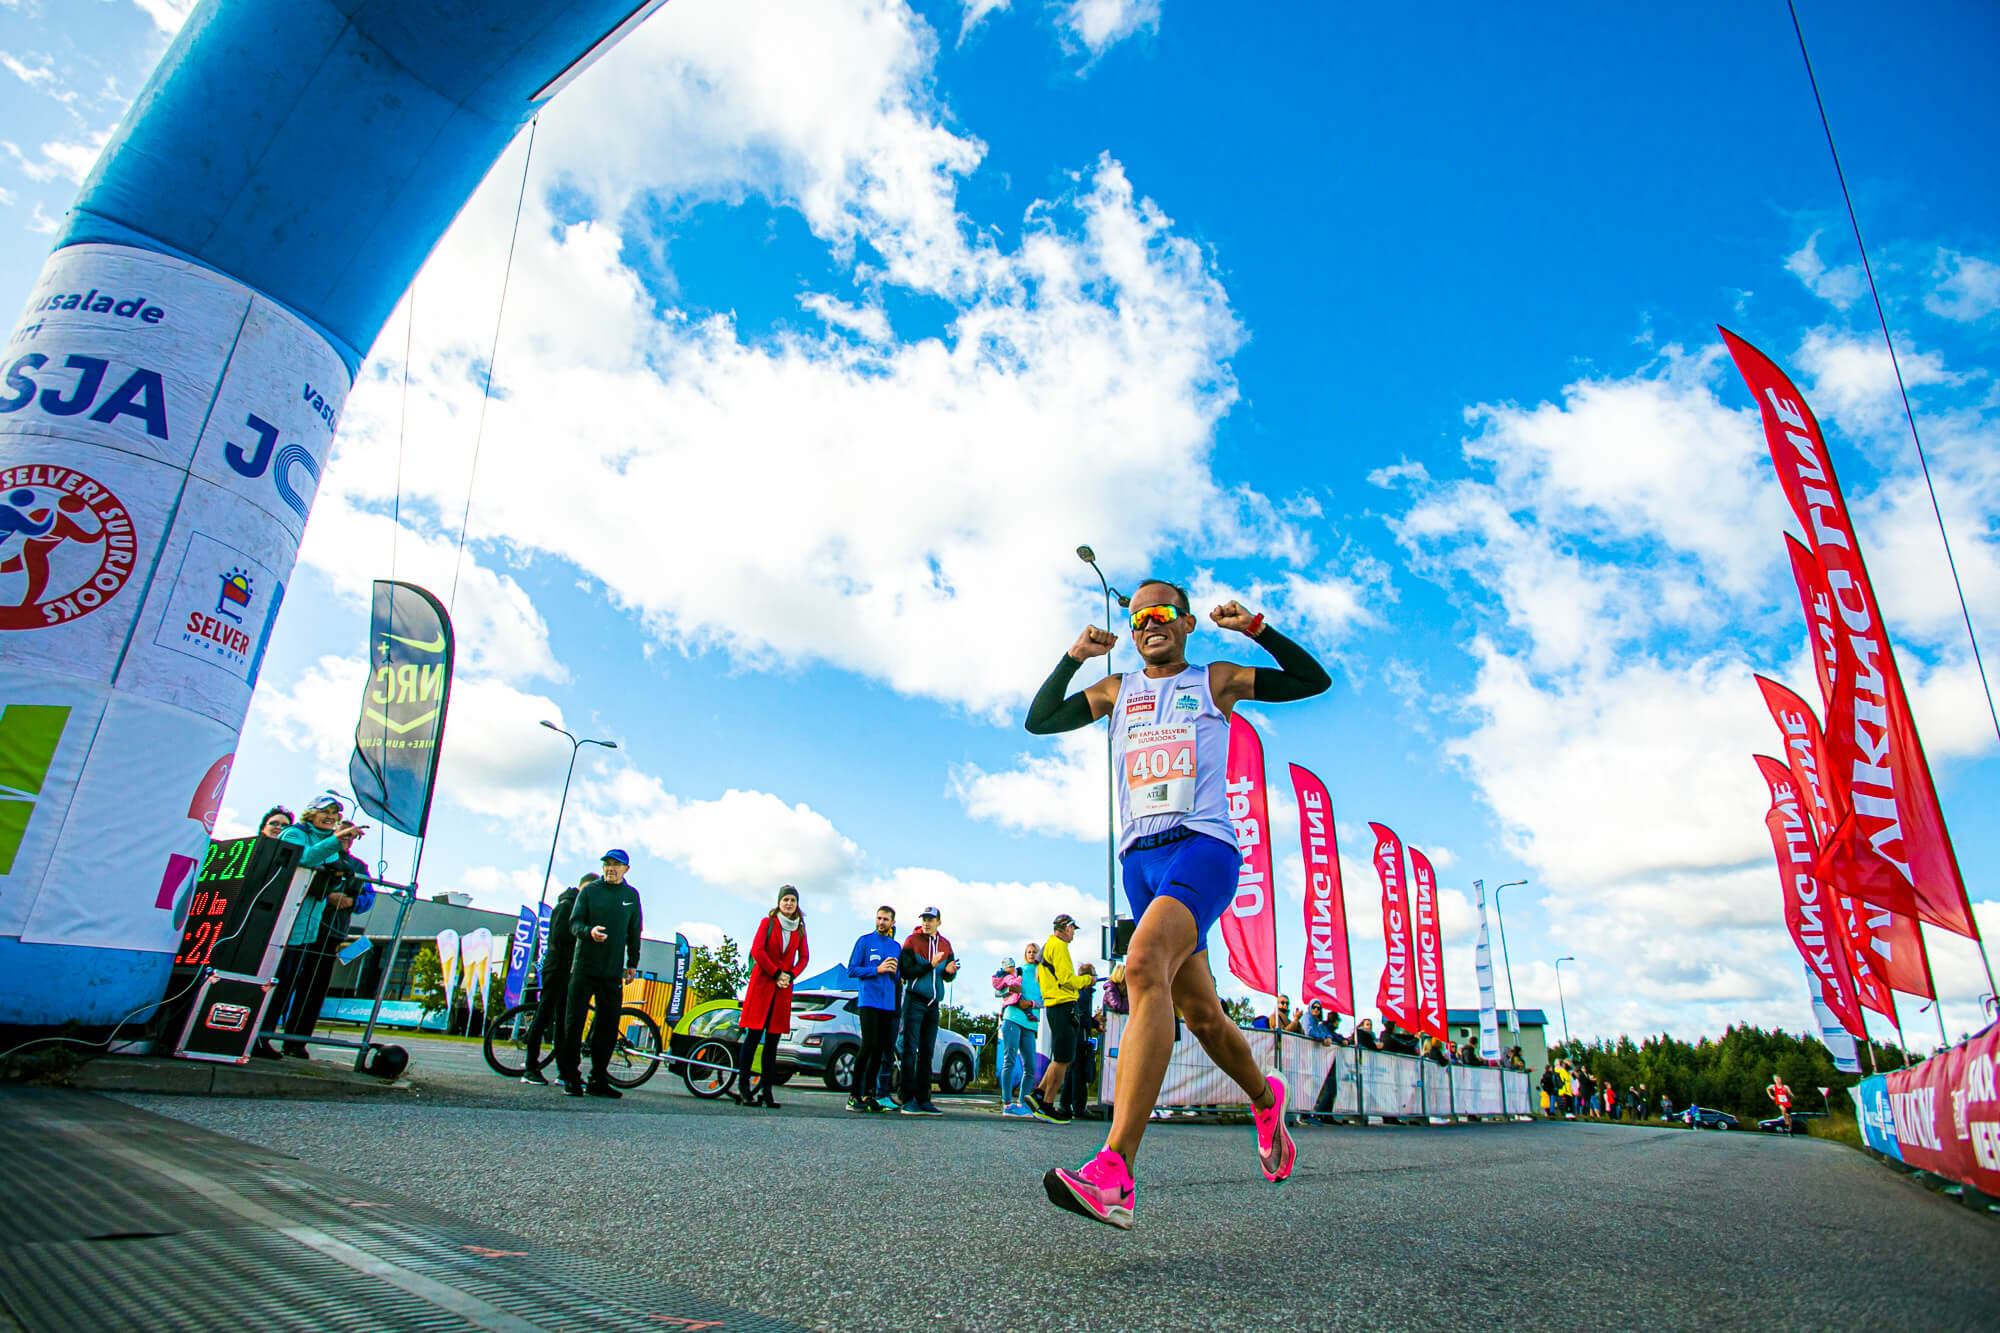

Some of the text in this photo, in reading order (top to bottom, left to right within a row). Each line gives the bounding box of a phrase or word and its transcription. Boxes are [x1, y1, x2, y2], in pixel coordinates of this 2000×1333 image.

[0, 353, 169, 440] SJA
[42, 507, 134, 624] SUURJOOKS
[186, 611, 250, 656] SELVER
[1132, 748, 1193, 780] 404
[1136, 834, 1156, 849] IKE
